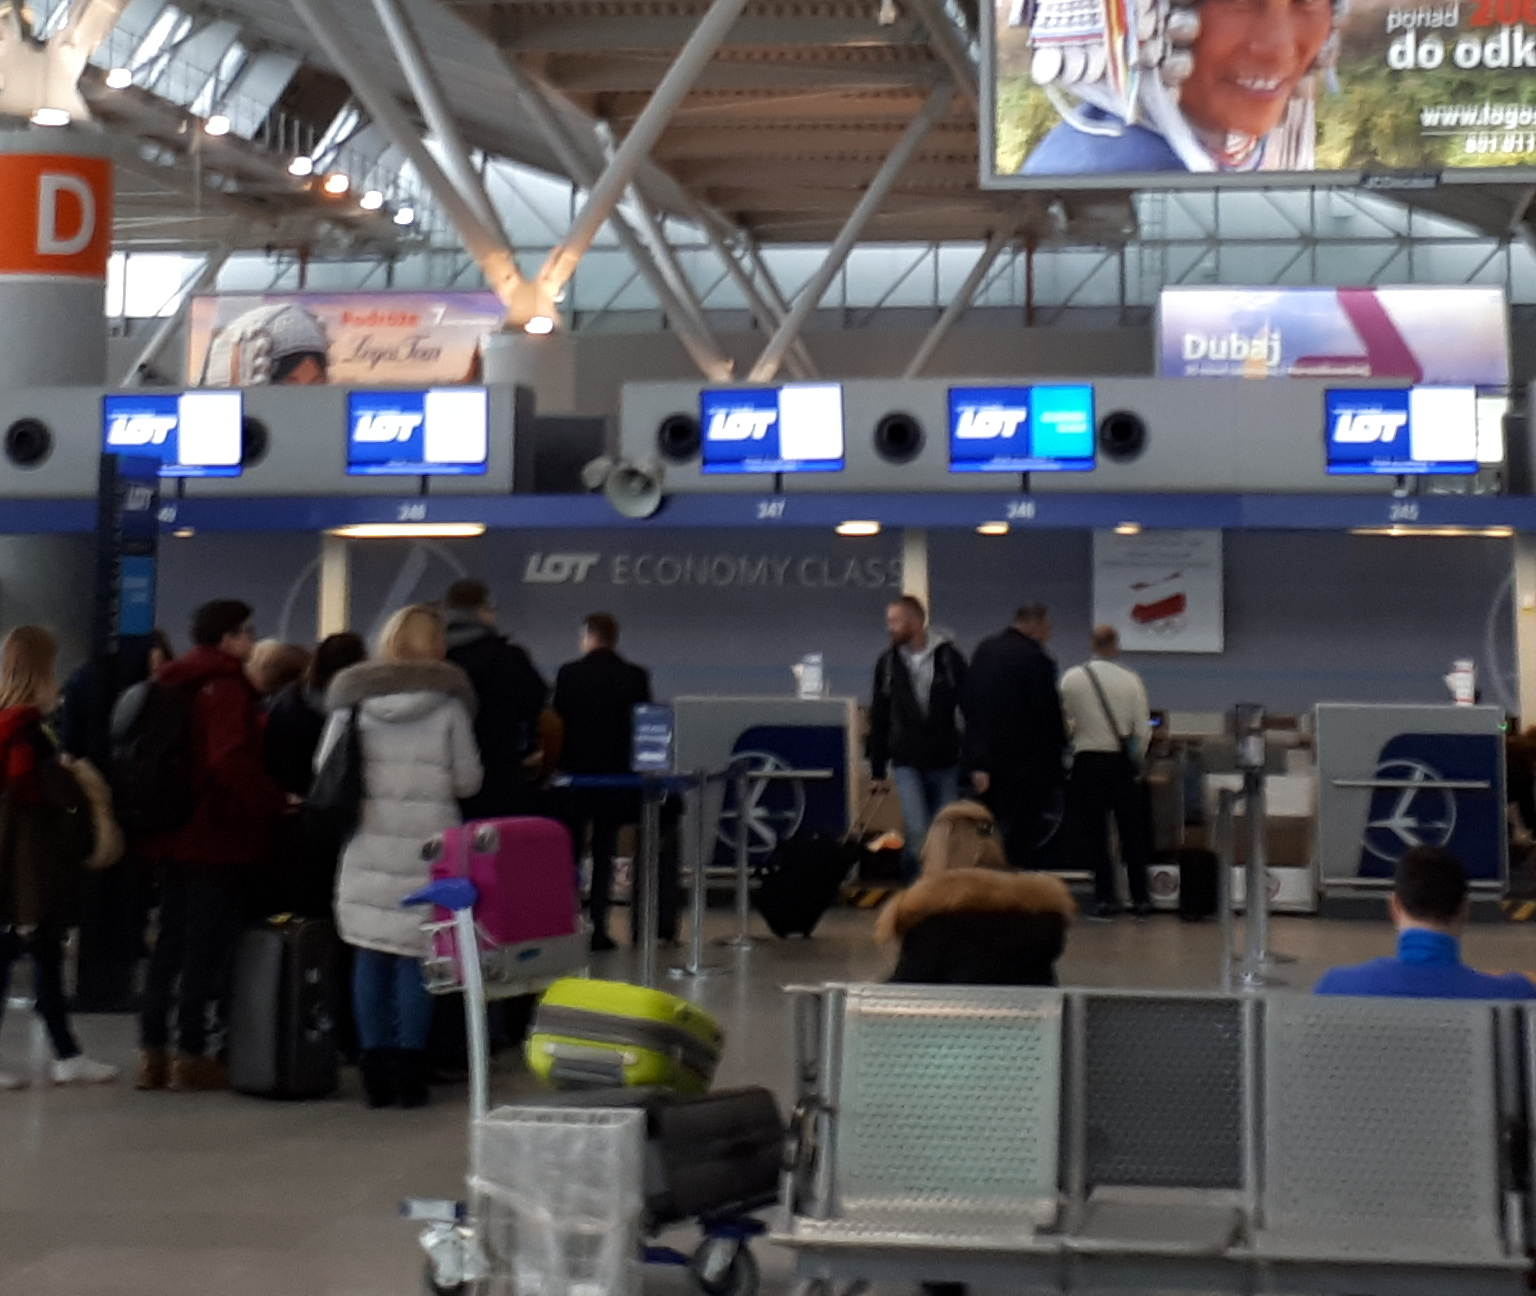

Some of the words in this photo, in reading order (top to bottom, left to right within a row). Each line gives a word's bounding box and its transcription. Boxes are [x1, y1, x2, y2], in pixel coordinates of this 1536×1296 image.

[1387, 1, 1459, 33] ponad
[1387, 28, 1445, 70] do
[37, 173, 96, 254] D
[1183, 329, 1282, 366] Dubaj
[106, 415, 178, 445] LOT
[352, 412, 424, 442] LOT
[707, 410, 777, 440] LOT
[955, 408, 1027, 439] LOT
[1333, 412, 1408, 442] LOT
[522, 552, 602, 584] LOT
[611, 554, 793, 586] ECONOMY
